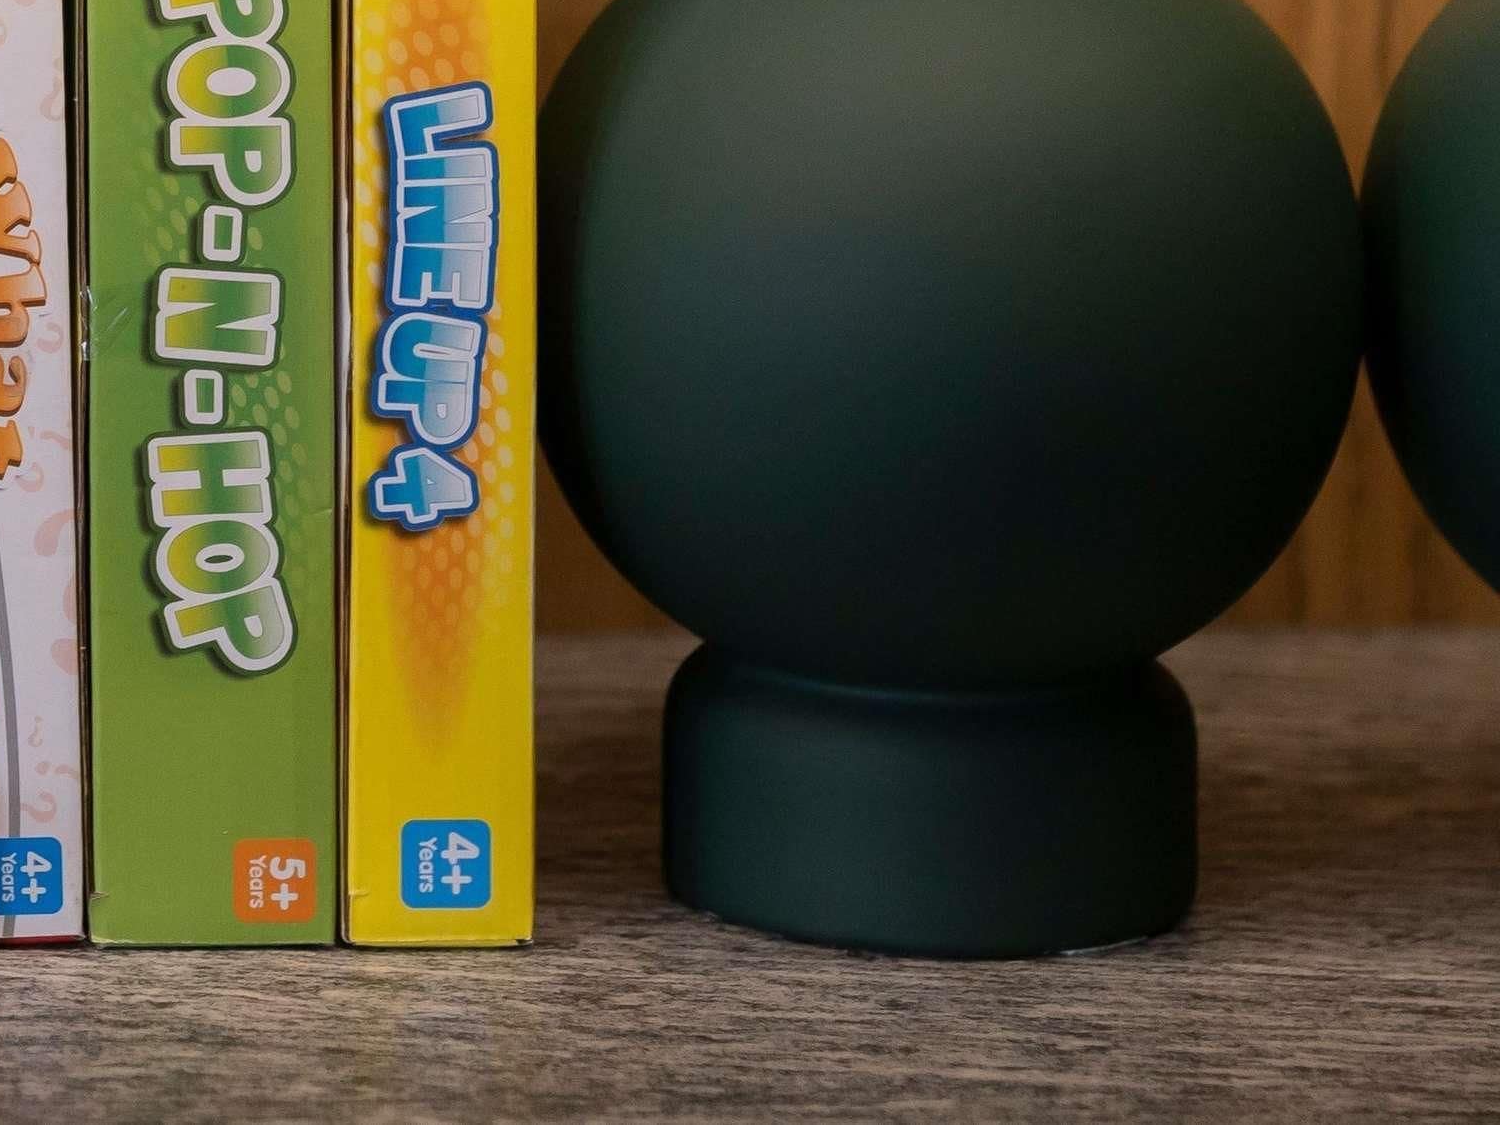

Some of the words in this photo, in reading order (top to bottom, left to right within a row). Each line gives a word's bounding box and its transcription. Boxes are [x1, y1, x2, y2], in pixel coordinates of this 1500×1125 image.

[368, 447, 480, 533] 4
[0, 852, 17, 903] Years
[19, 850, 53, 904] 4+
[248, 854, 265, 909] Years
[268, 855, 307, 910] 5+
[418, 836, 437, 893] Years
[440, 831, 481, 895] 4+
